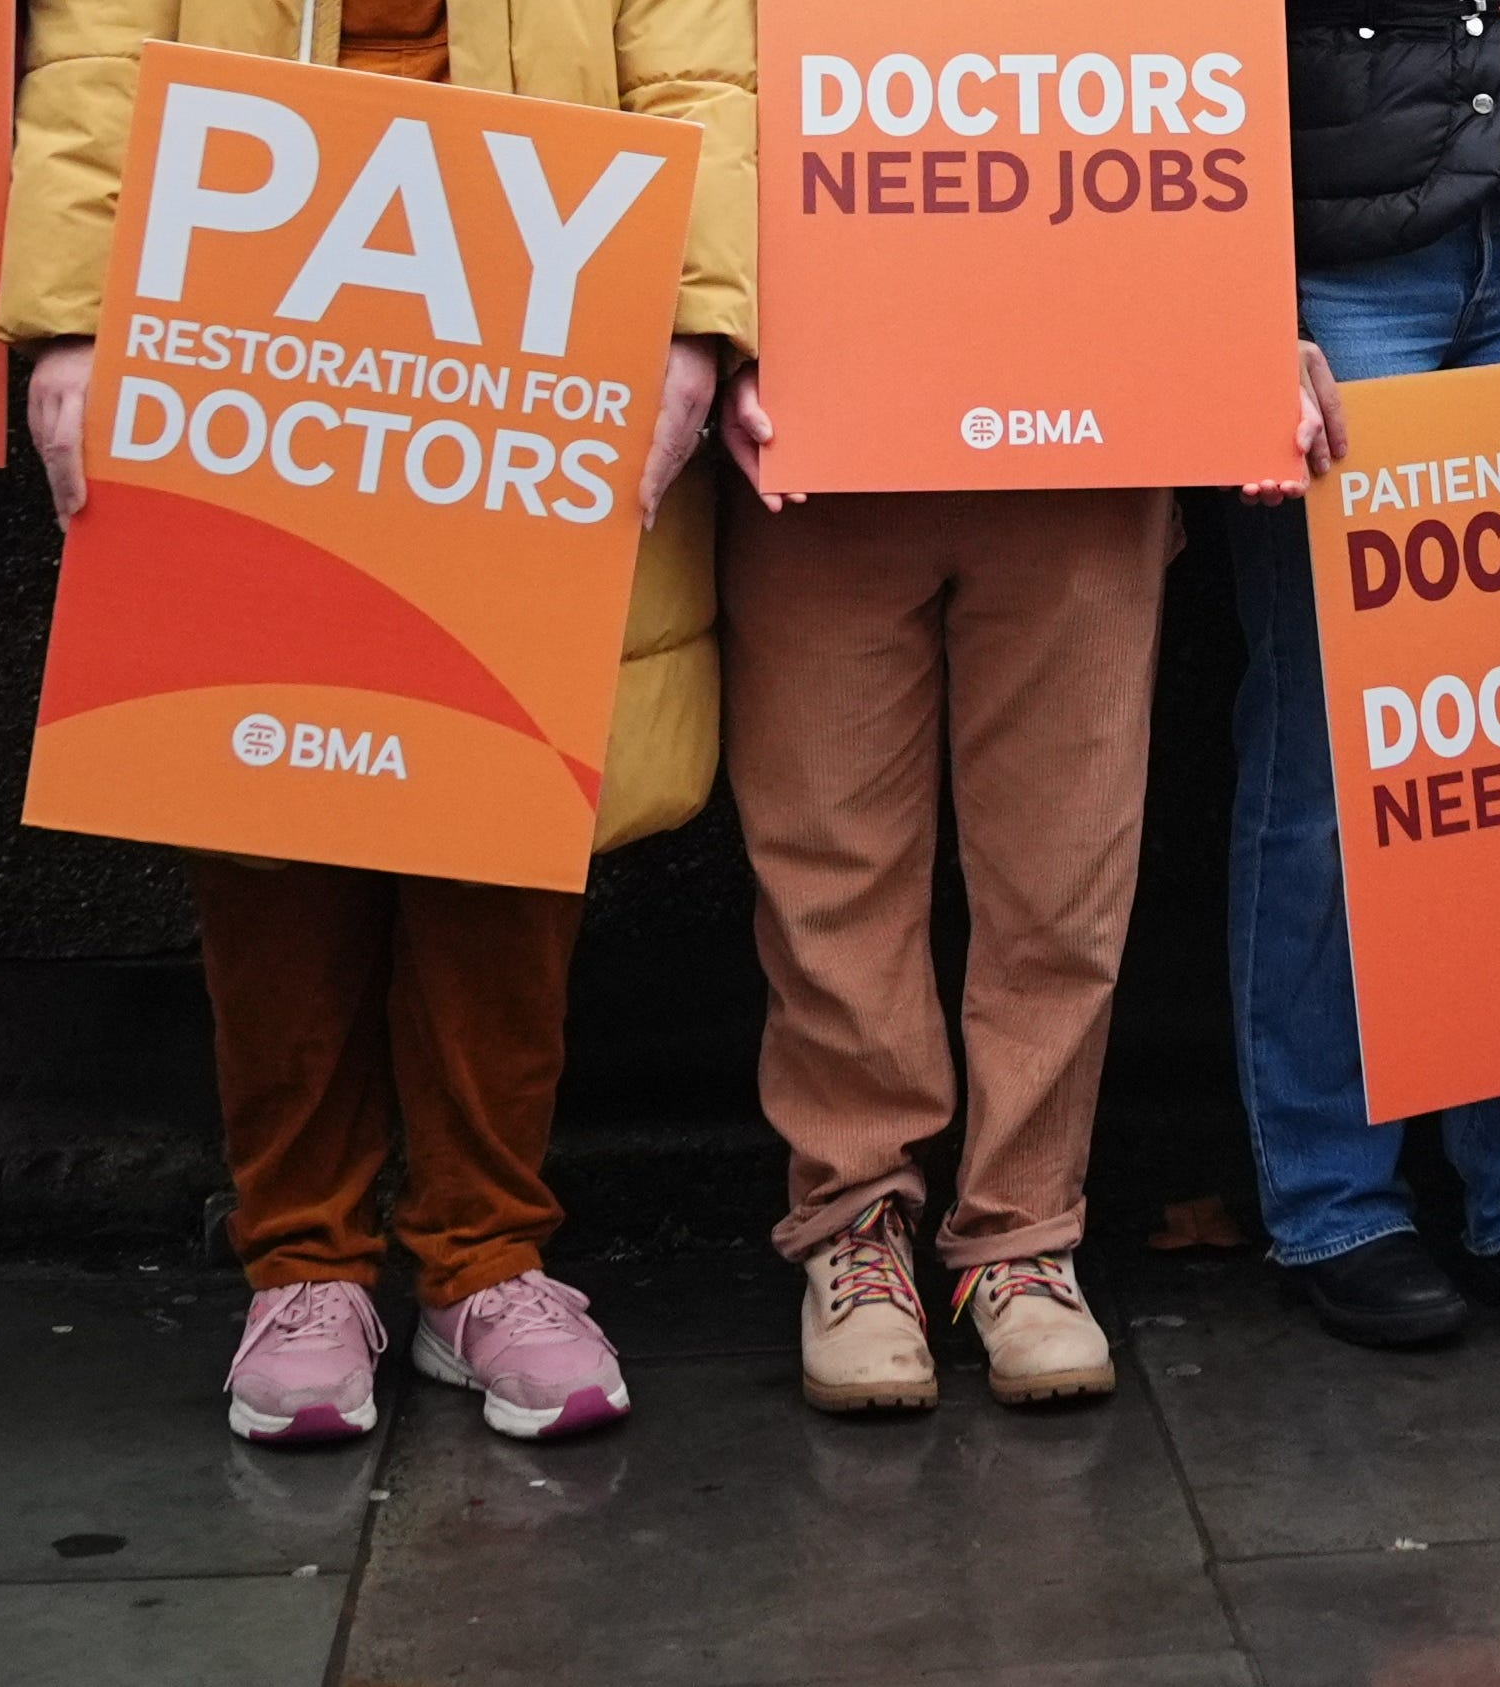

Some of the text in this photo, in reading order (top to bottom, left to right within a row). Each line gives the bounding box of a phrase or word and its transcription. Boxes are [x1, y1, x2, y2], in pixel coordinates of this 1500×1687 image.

[801, 53, 1246, 136] DOCTORS
[136, 82, 667, 357] PAY
[803, 148, 1248, 225] NEED JOBS
[127, 315, 631, 426] RESTORATION FOR
[110, 376, 619, 523] DOCTORS
[1008, 410, 1103, 444] BMA
[289, 722, 408, 779] BMA
